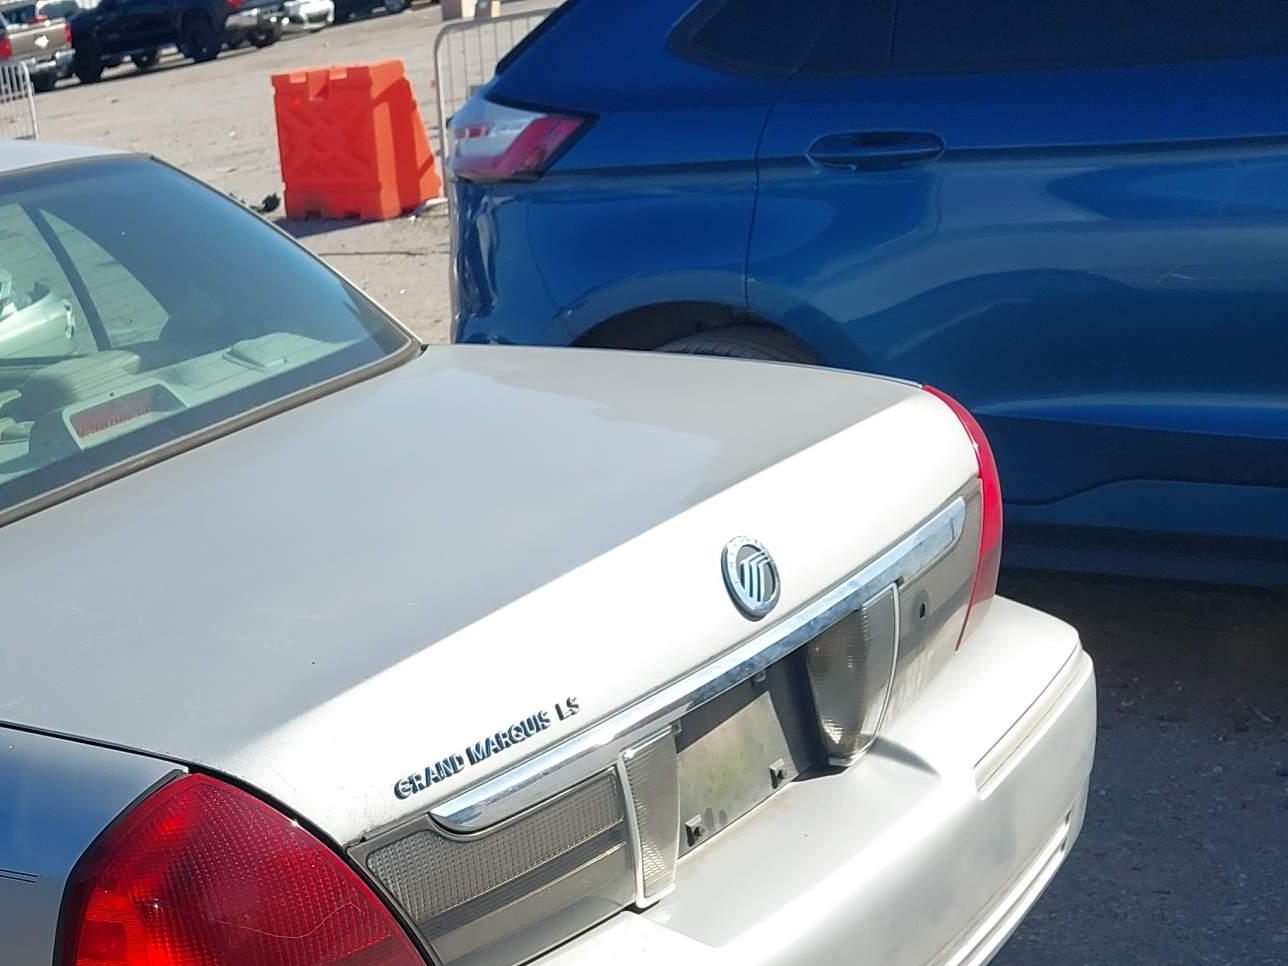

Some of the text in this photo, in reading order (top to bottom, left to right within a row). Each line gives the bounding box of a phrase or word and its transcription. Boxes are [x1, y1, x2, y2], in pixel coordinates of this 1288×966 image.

[394, 696, 580, 800] GRAND MARQUIS LS
